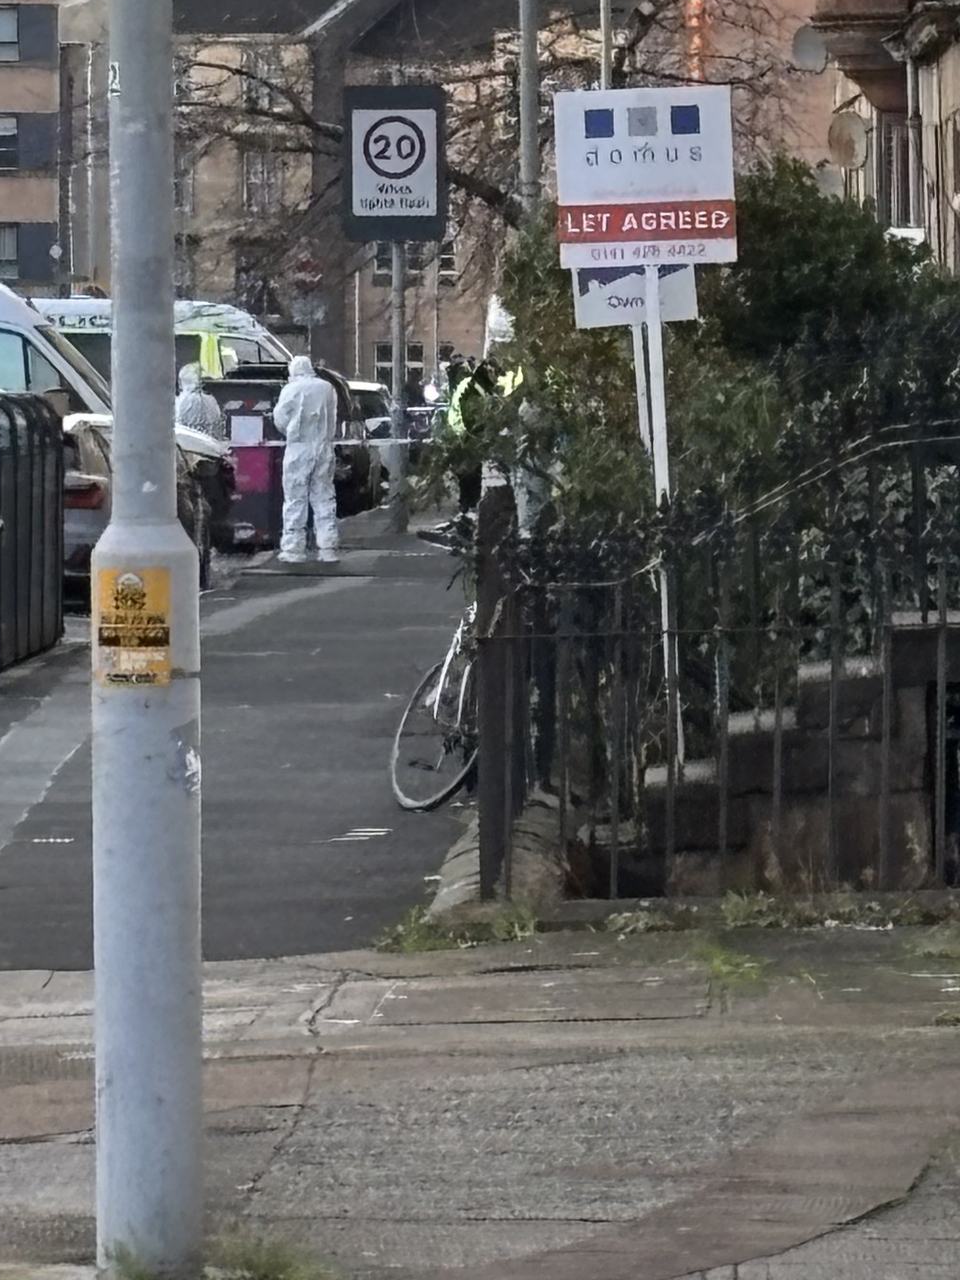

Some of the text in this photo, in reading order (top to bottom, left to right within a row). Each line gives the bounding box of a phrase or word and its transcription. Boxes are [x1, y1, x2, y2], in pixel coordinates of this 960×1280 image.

[373, 134, 416, 160] 20
[585, 144, 703, 167] domus
[567, 210, 731, 233] LET AGREED
